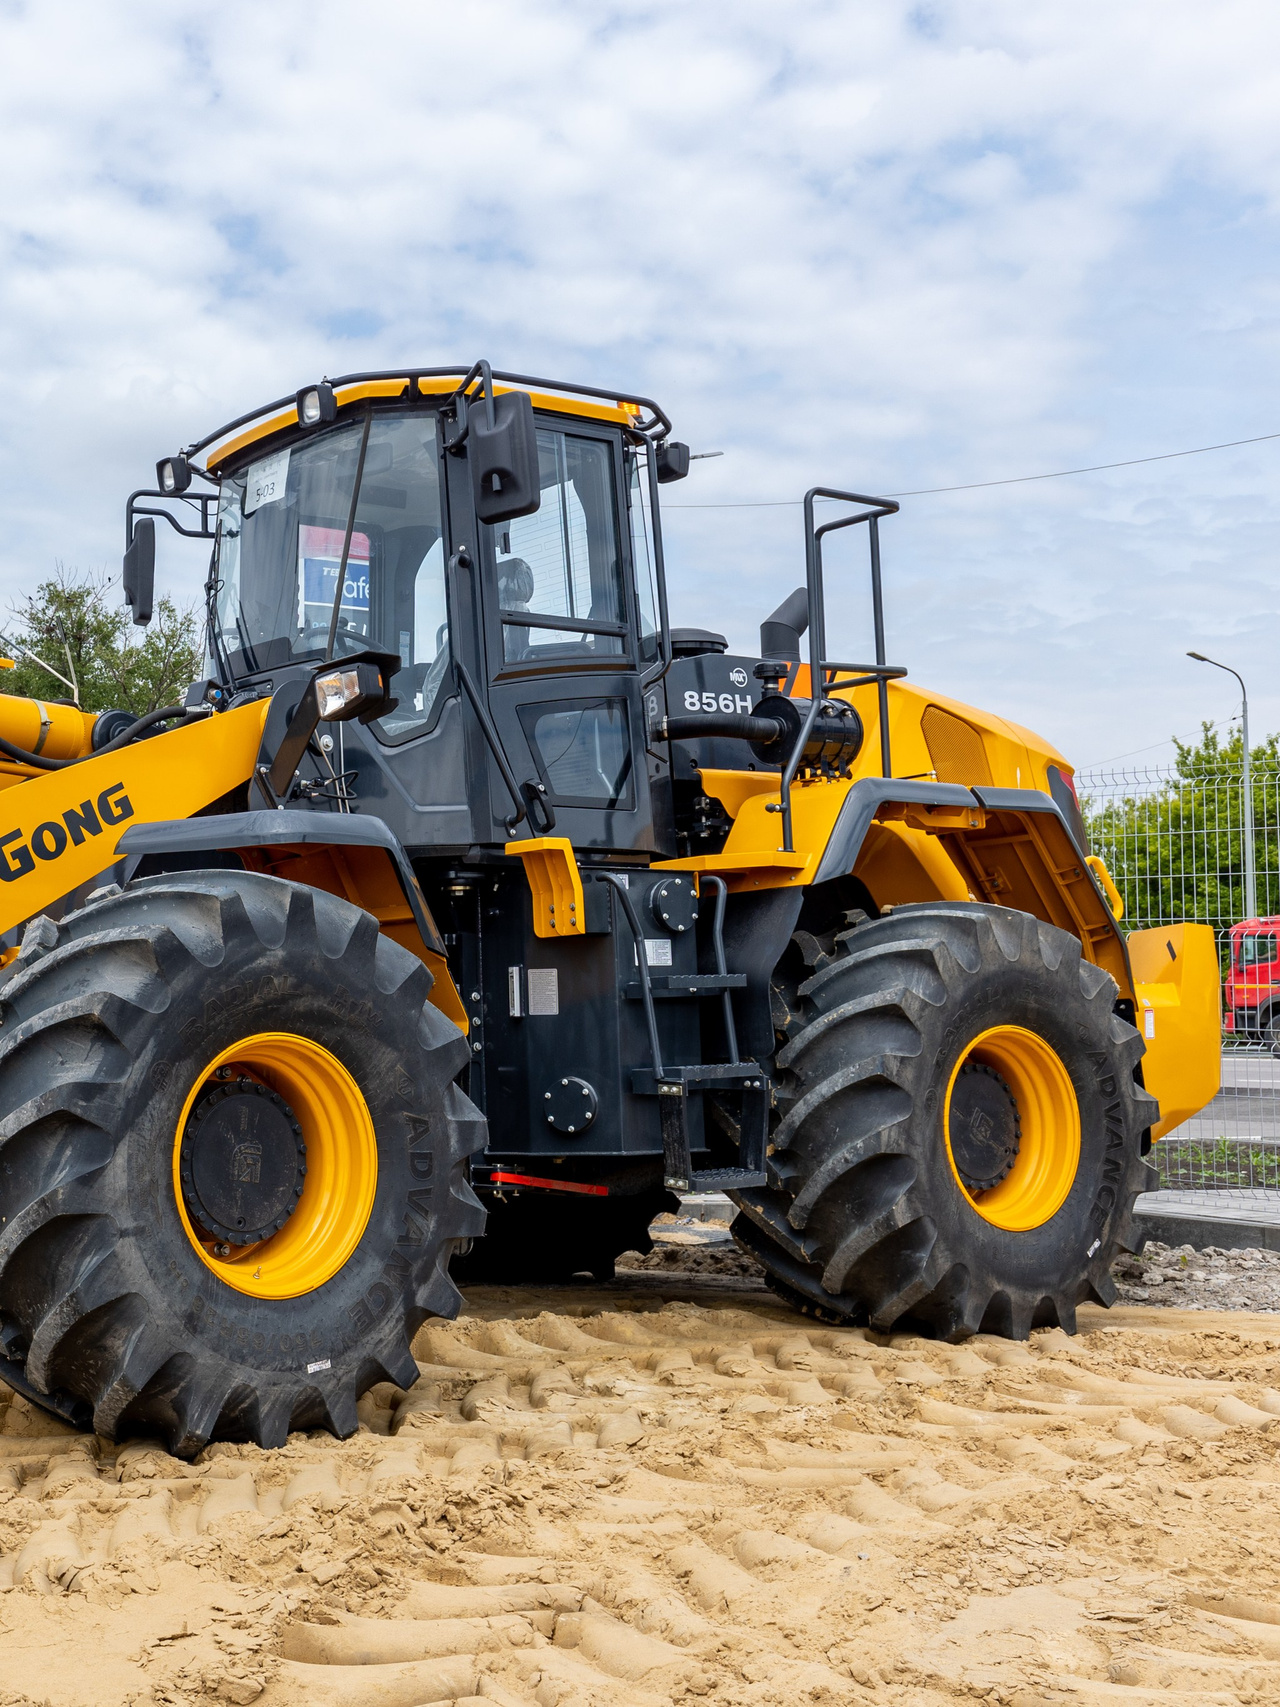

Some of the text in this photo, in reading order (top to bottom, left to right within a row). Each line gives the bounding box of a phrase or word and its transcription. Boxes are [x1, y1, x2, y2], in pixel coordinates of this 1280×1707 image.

[684, 691, 753, 714] 856H
[348, 1111, 433, 1335] ADVANCE
[1085, 1050, 1124, 1228] ADVANCE
